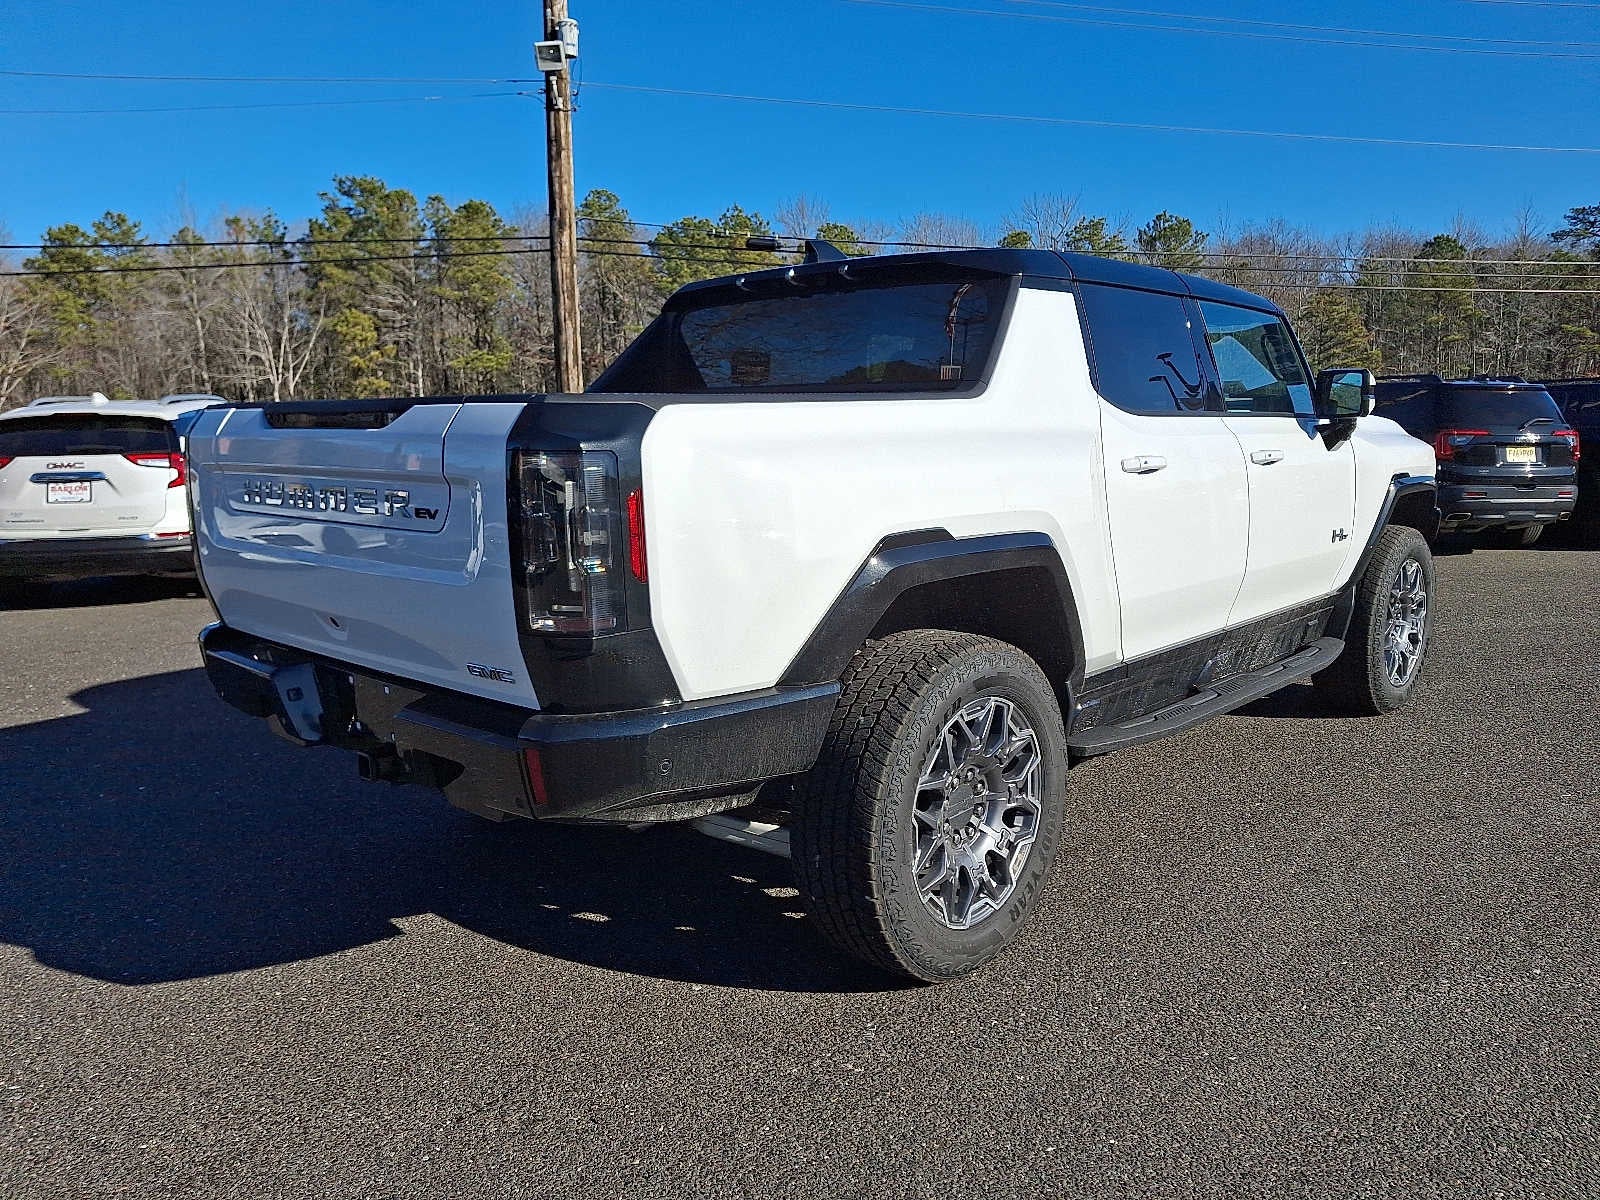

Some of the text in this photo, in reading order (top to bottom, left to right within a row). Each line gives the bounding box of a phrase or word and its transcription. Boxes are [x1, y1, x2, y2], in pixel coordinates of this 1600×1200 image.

[243, 479, 439, 520] HUMMER EV
[466, 662, 516, 684] GMC
